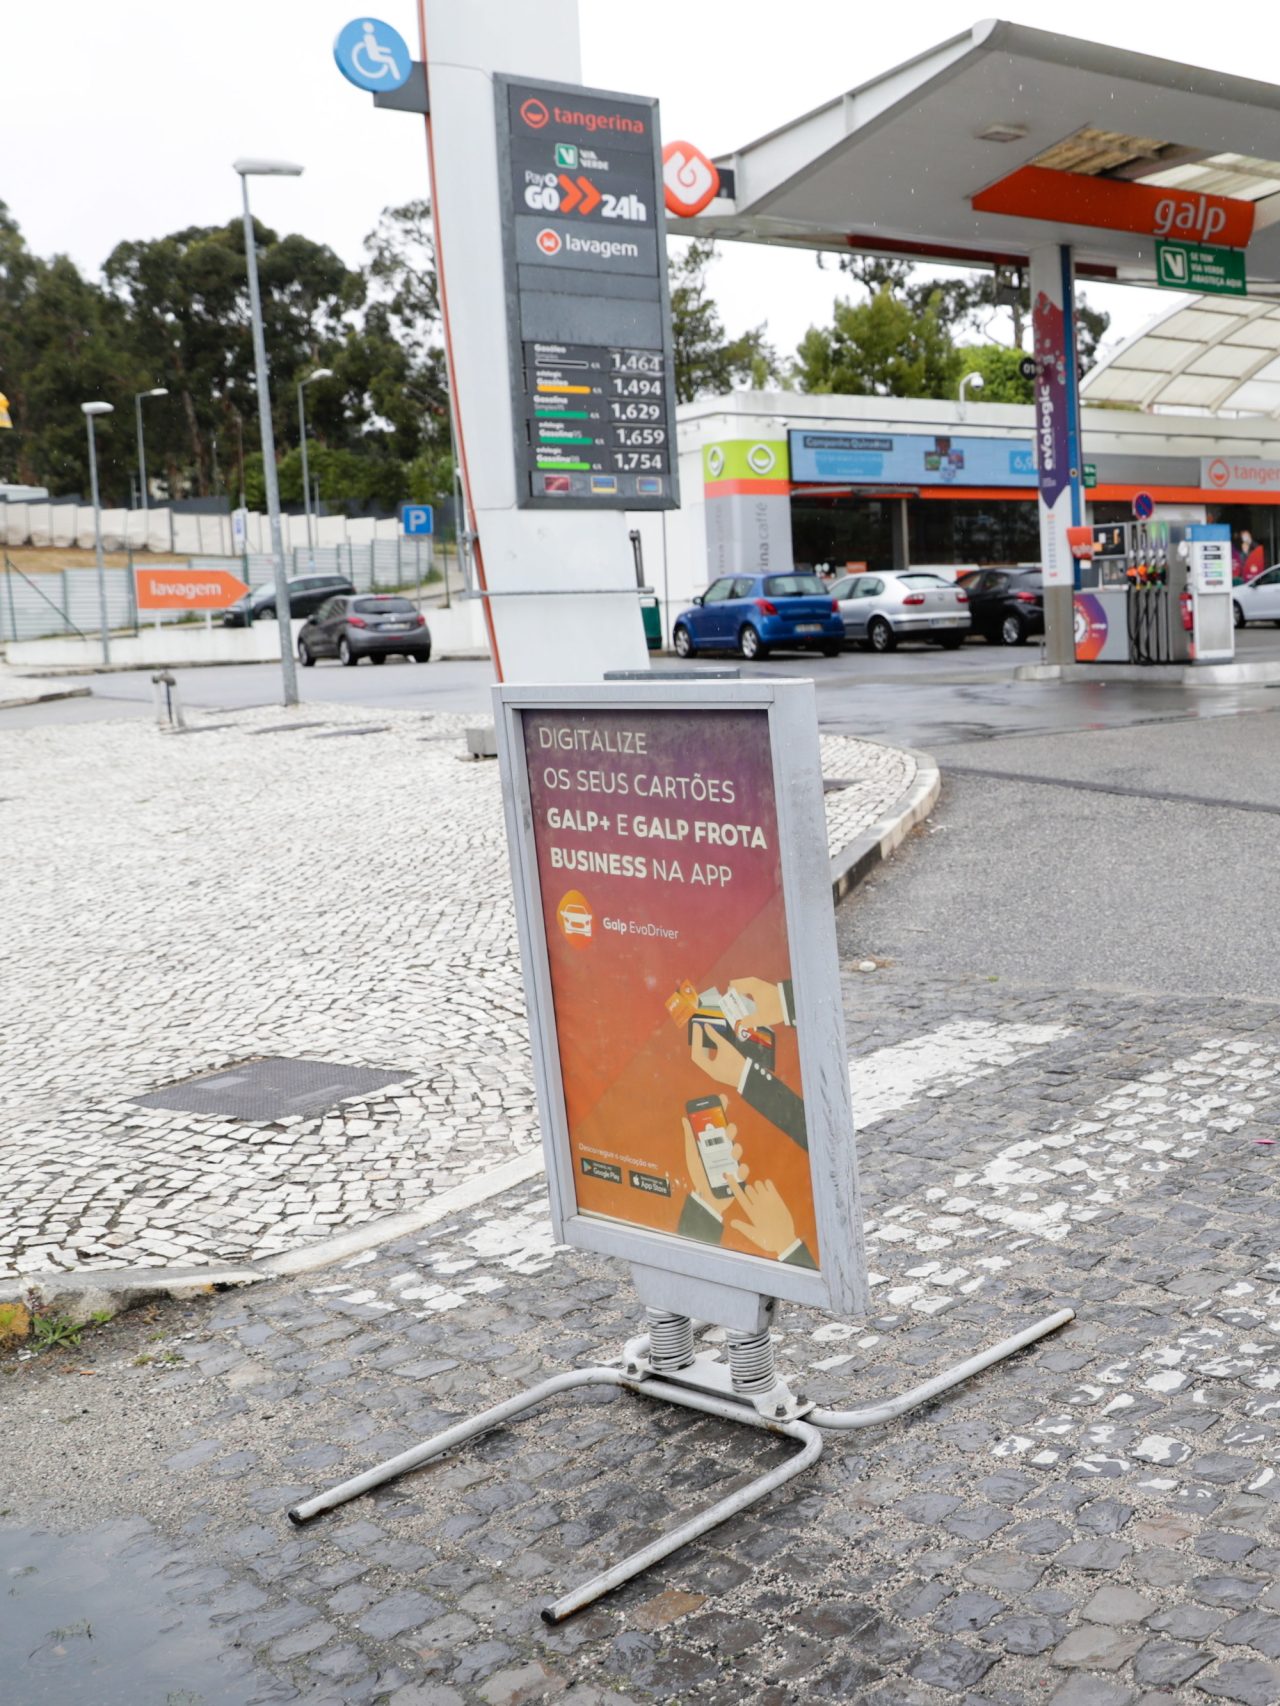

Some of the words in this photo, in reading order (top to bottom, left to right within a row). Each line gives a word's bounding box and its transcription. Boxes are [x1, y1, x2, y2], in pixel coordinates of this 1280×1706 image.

[554, 107, 644, 133] tangerina
[579, 149, 598, 160] VIA
[579, 158, 609, 170] VERDE
[524, 185, 560, 211] GO
[601, 194, 647, 221] 24h
[1152, 196, 1226, 240] galp
[565, 233, 638, 258] lavagem
[1039, 384, 1054, 471] evologic
[409, 510, 428, 531] P
[149, 579, 222, 599] lavagem
[538, 727, 647, 755] DIGITALIZE
[543, 768, 570, 789] OS
[576, 770, 629, 795] SEUS
[634, 773, 735, 803] CARTÕES
[547, 807, 610, 833] GALP+
[617, 814, 629, 836] E
[633, 816, 689, 842] GALP
[694, 822, 768, 850] FROTA
[550, 848, 647, 878] BUSINESS
[653, 859, 684, 883] NA
[691, 863, 732, 888] APP
[603, 917, 627, 934] Galp
[629, 922, 679, 940] EvoDriver
[592, 1167, 610, 1178] Google
[641, 1181, 653, 1191] App
[653, 1183, 667, 1194] Store
